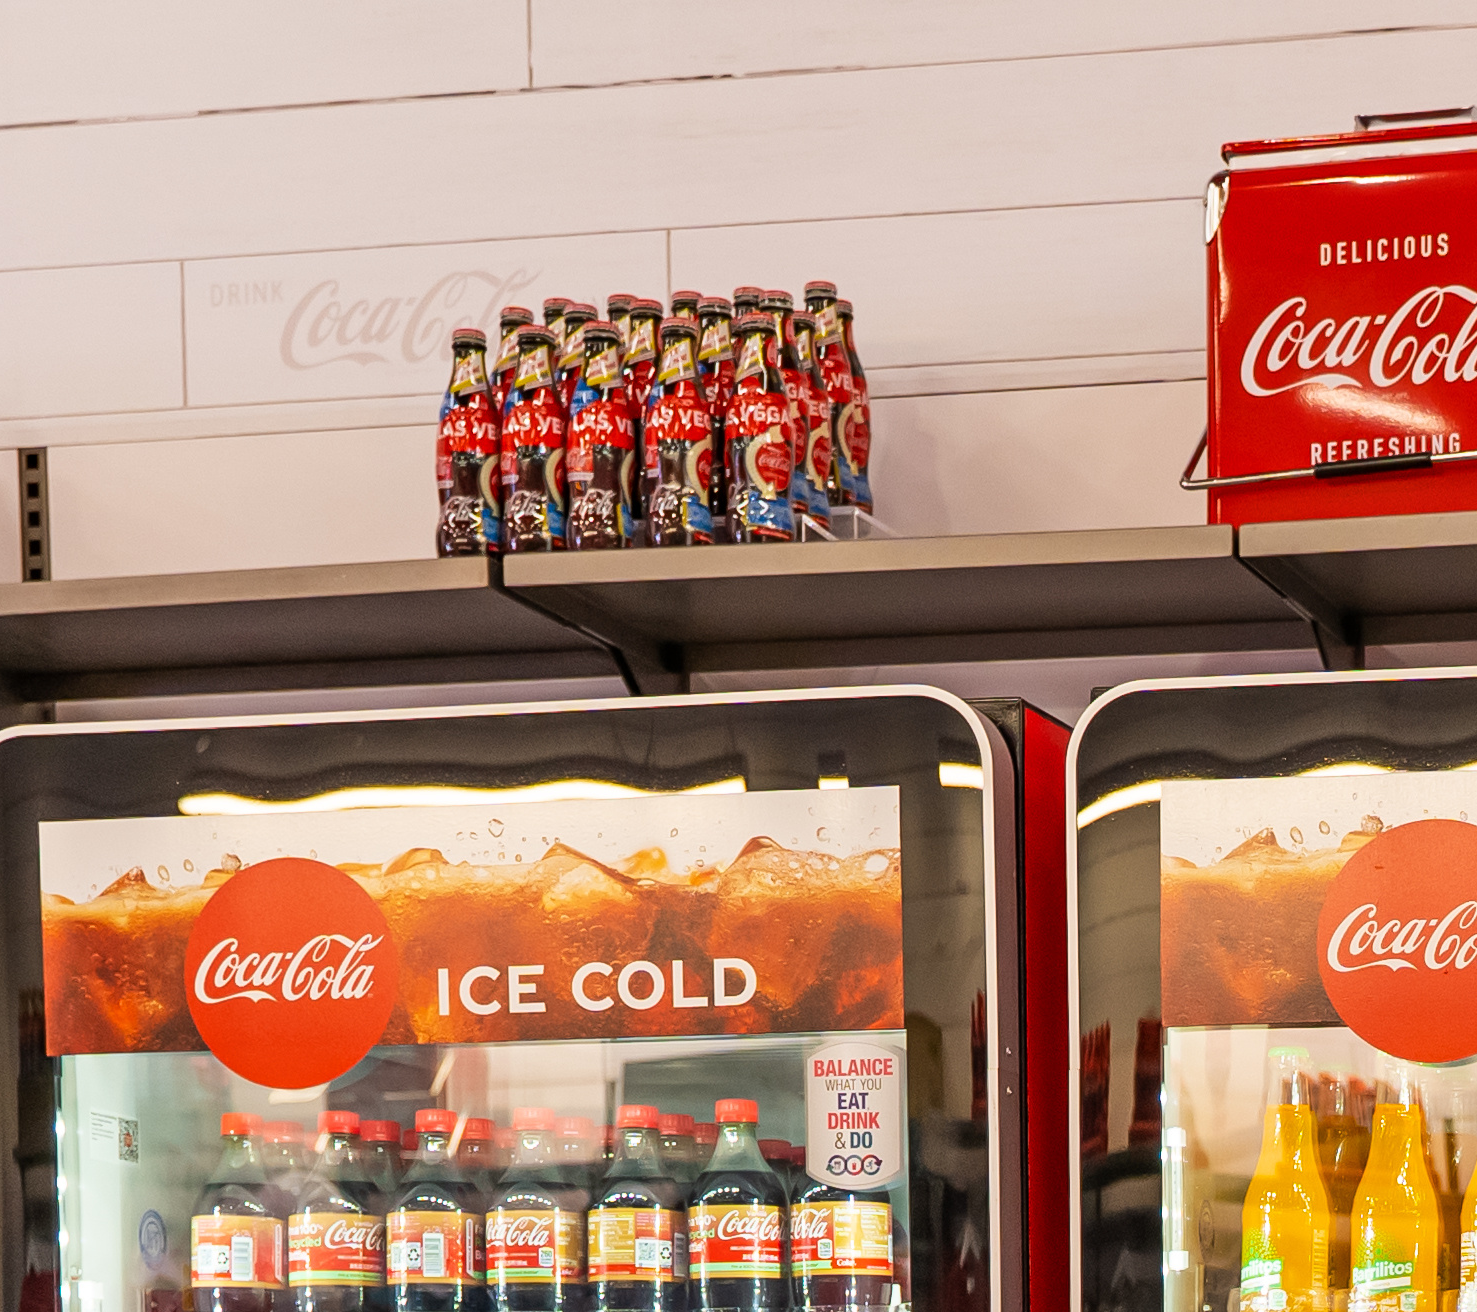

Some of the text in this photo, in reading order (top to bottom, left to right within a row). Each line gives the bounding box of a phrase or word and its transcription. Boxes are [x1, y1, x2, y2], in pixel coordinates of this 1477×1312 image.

[1320, 233, 1449, 267] DELICIOUS
[209, 281, 284, 308] DRINK
[195, 933, 384, 1004] Coca-Cola
[438, 957, 758, 1017] ICE COLD
[813, 1057, 894, 1078] BALANCE
[825, 1077, 883, 1092] WHAT YOU
[827, 1111, 881, 1131] DRINK
[834, 1131, 874, 1150] & DO
